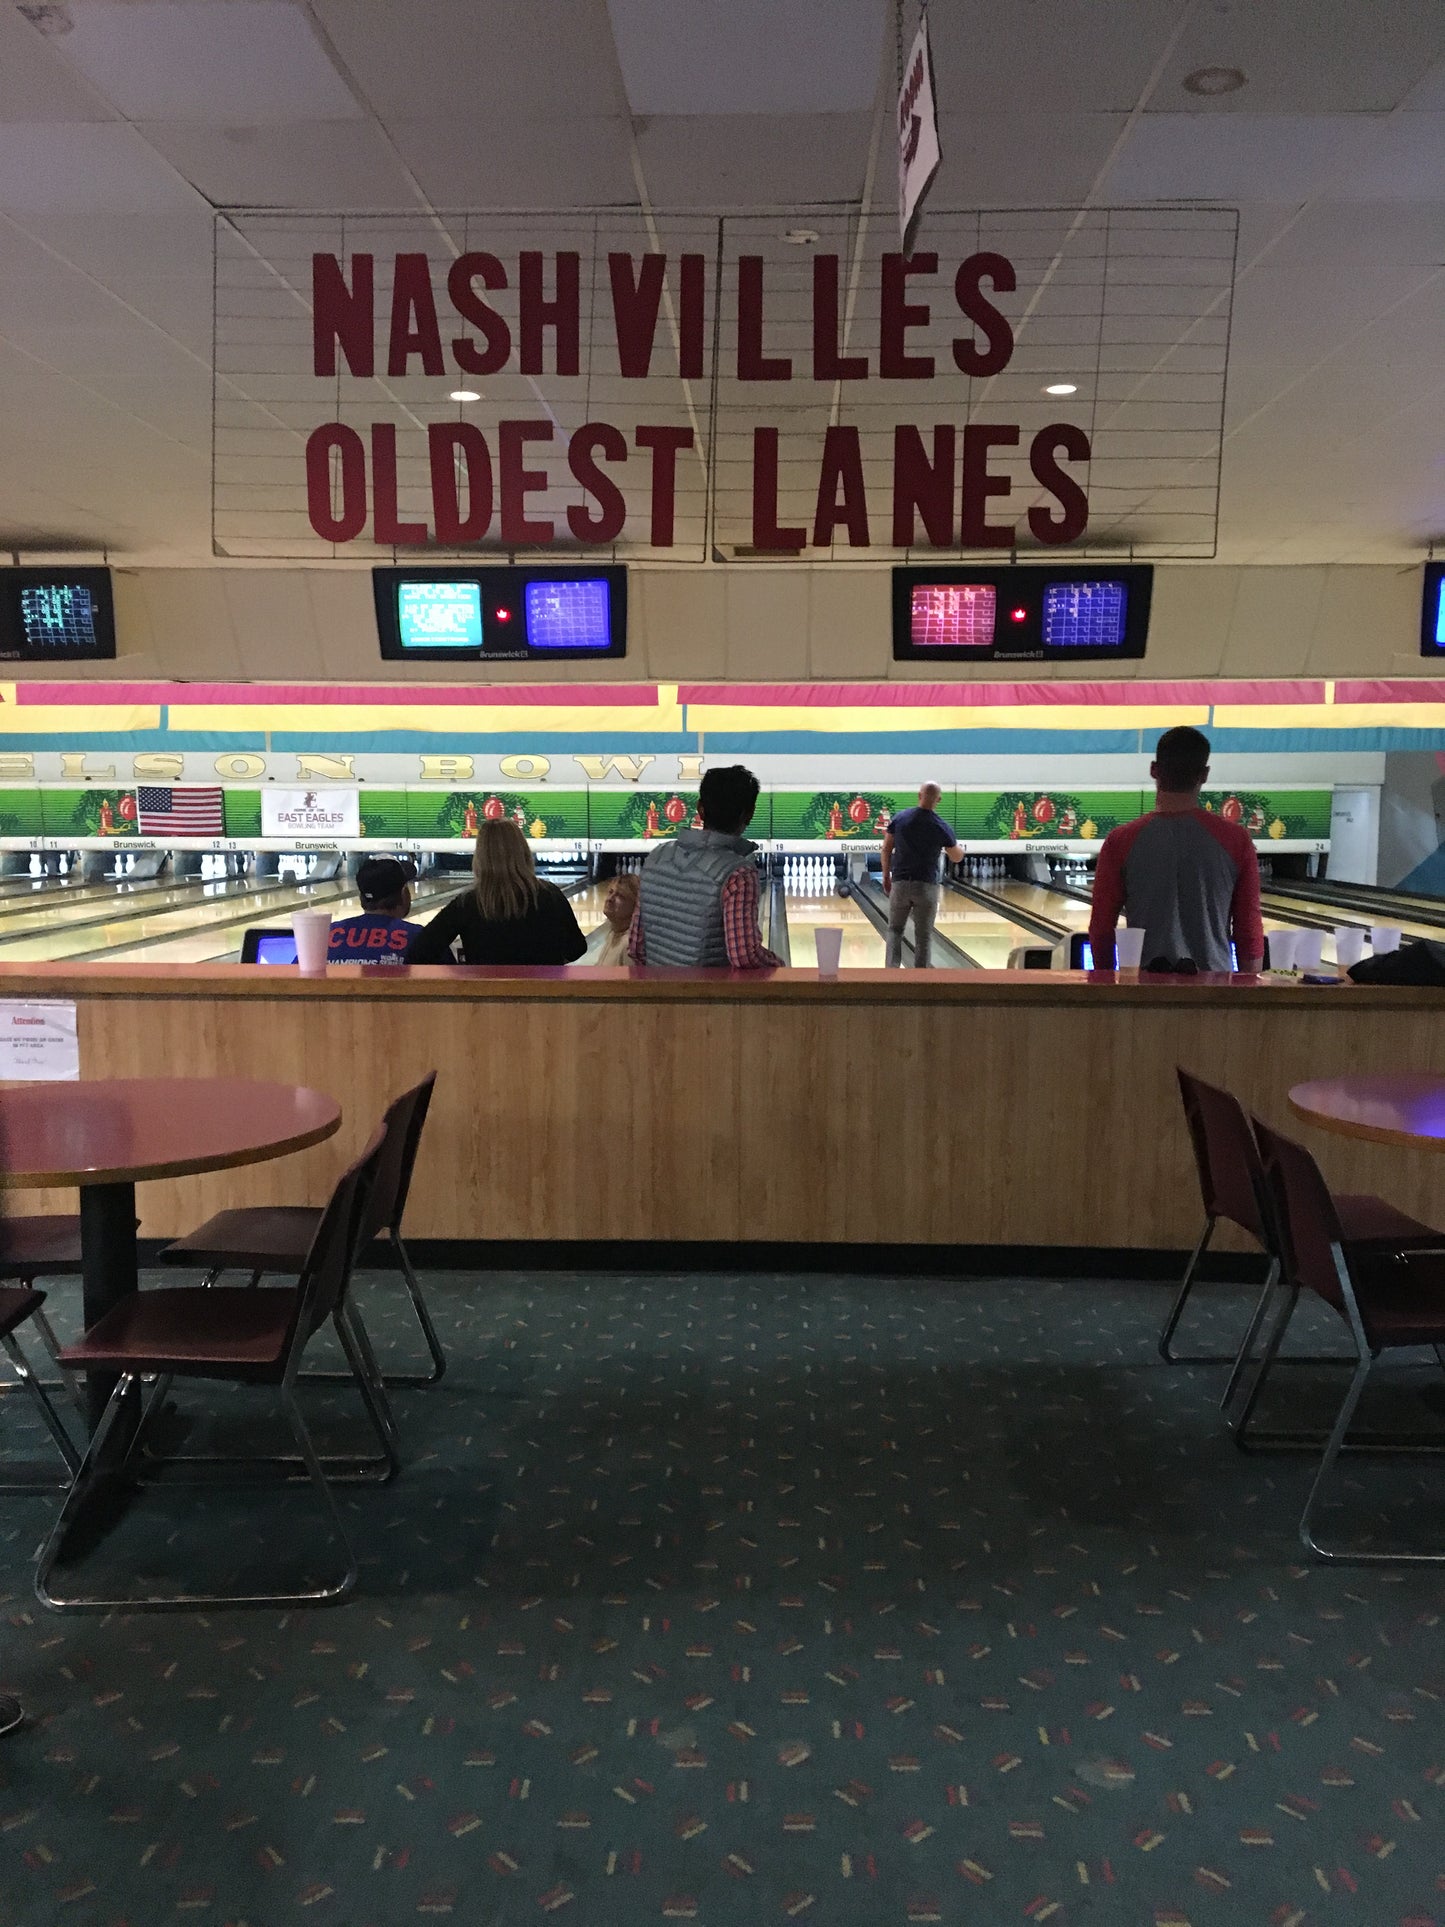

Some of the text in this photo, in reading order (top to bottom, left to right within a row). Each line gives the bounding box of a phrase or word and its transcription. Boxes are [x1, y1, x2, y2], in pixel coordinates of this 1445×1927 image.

[313, 251, 1017, 380] NASHVILLES
[305, 420, 1092, 551] OLDEST LANES
[278, 813, 344, 822] EAST EAGLES
[328, 927, 408, 950] CUBS
